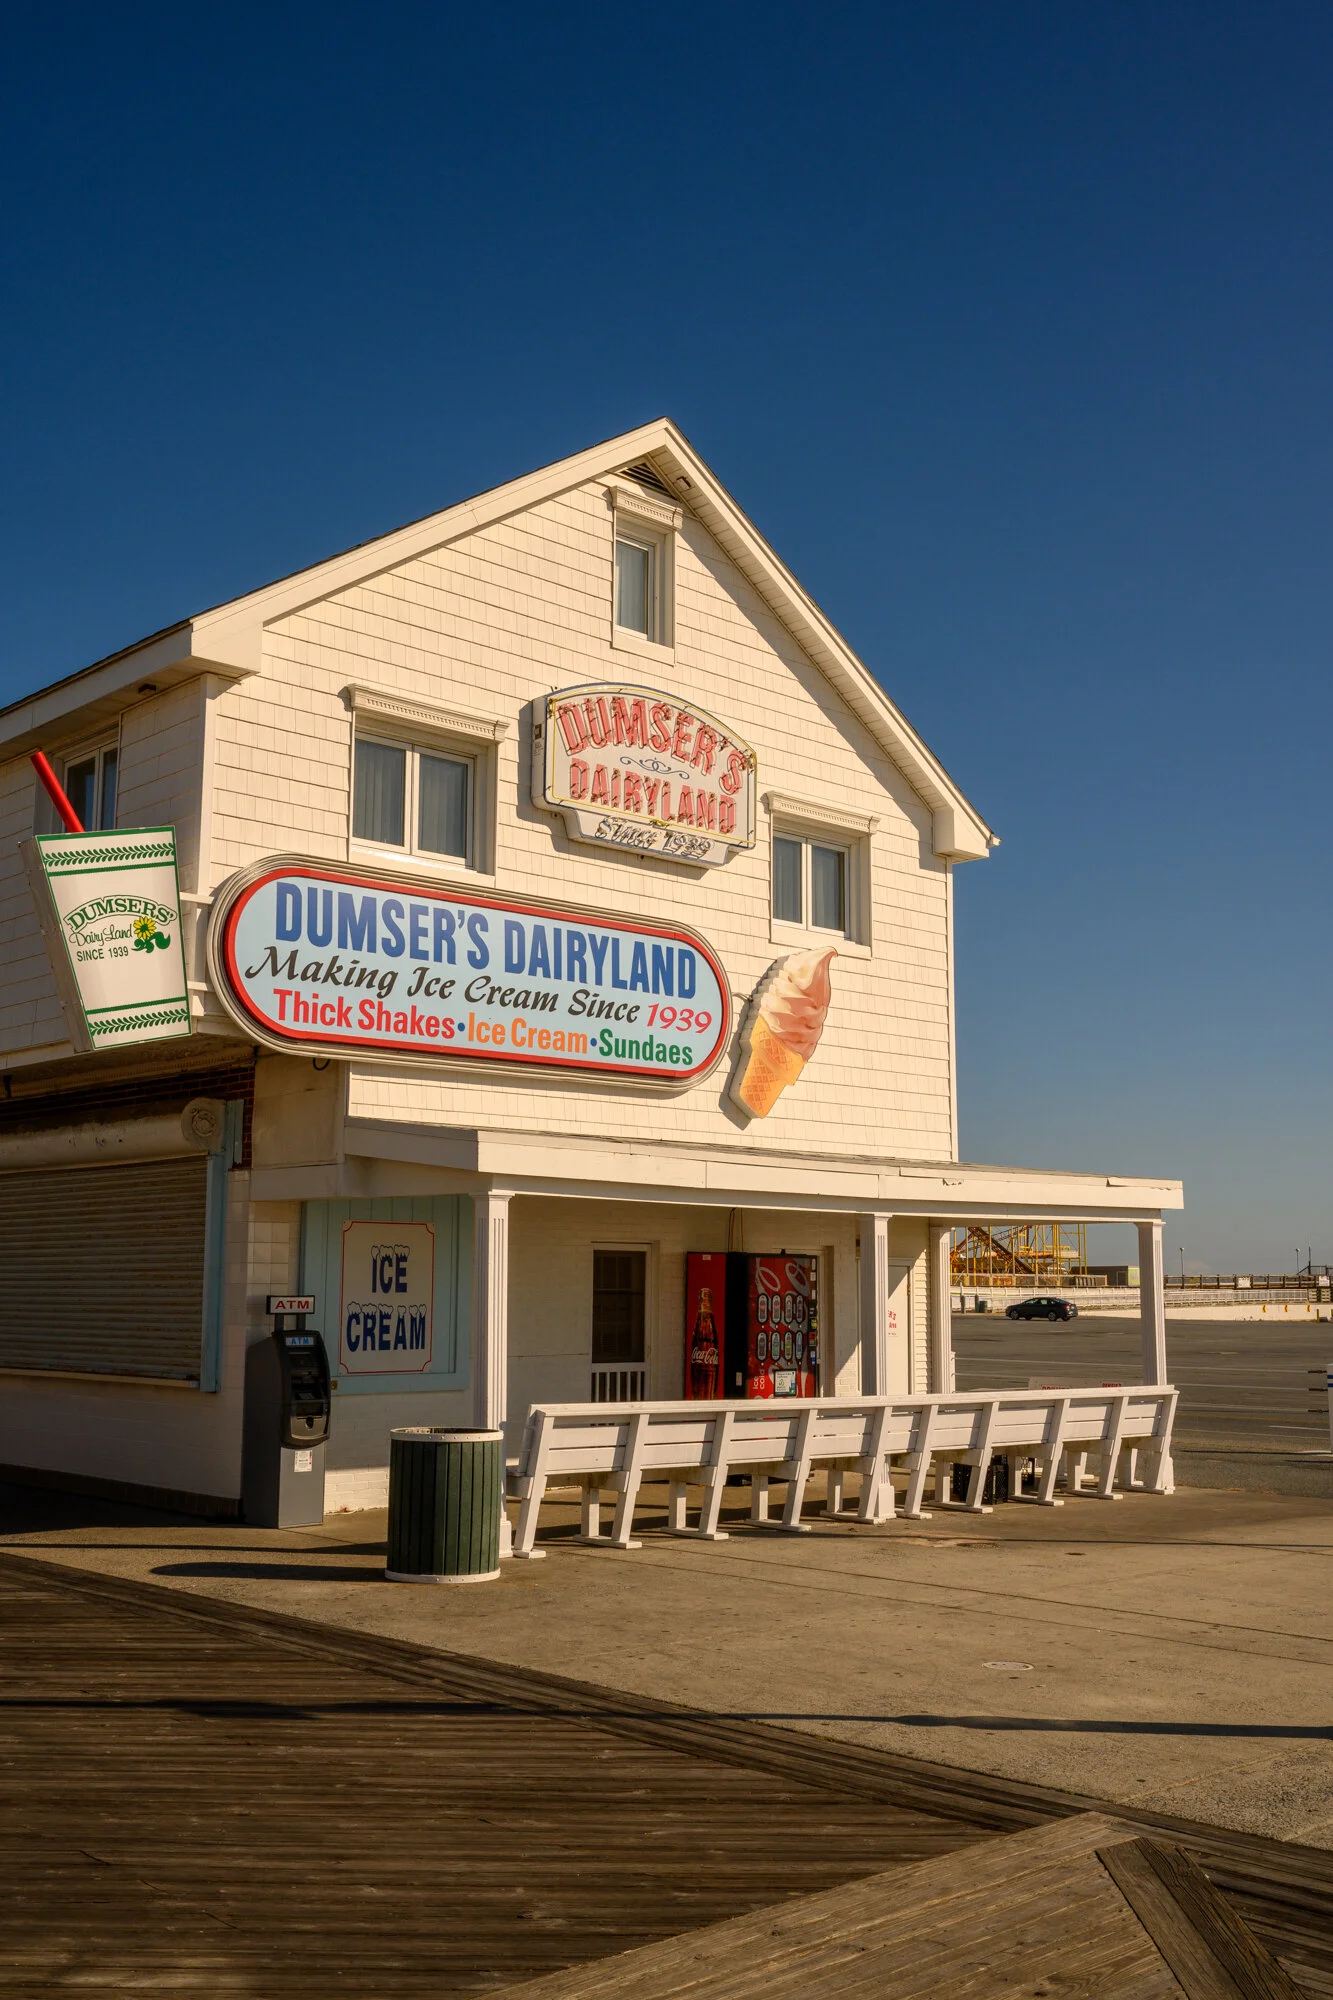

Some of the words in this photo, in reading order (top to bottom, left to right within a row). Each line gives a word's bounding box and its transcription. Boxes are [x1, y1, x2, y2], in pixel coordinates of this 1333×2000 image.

[556, 696, 747, 795] DUMSER'S
[570, 757, 737, 834] DAIRYLAND
[67, 898, 174, 930] DUMSERS'
[76, 948, 105, 962] SINCE
[108, 945, 129, 958] 1939
[275, 881, 490, 970] DUMSER'S
[504, 919, 697, 999] DAIRYLAND
[244, 945, 399, 999] Making
[407, 966, 457, 1000] Ice
[464, 975, 560, 1012] Cream
[567, 988, 641, 1023] Since
[646, 1003, 713, 1034] 1939
[273, 988, 353, 1028] Thick
[358, 999, 455, 1039] Shakes
[468, 1012, 506, 1045] Ice
[511, 1017, 588, 1054] Cream
[599, 1028, 693, 1066] Sundaes
[371, 1244, 411, 1294] ICE
[275, 1300, 310, 1310] ATM
[346, 1301, 428, 1352] CREAM
[290, 1336, 310, 1345] ATM
